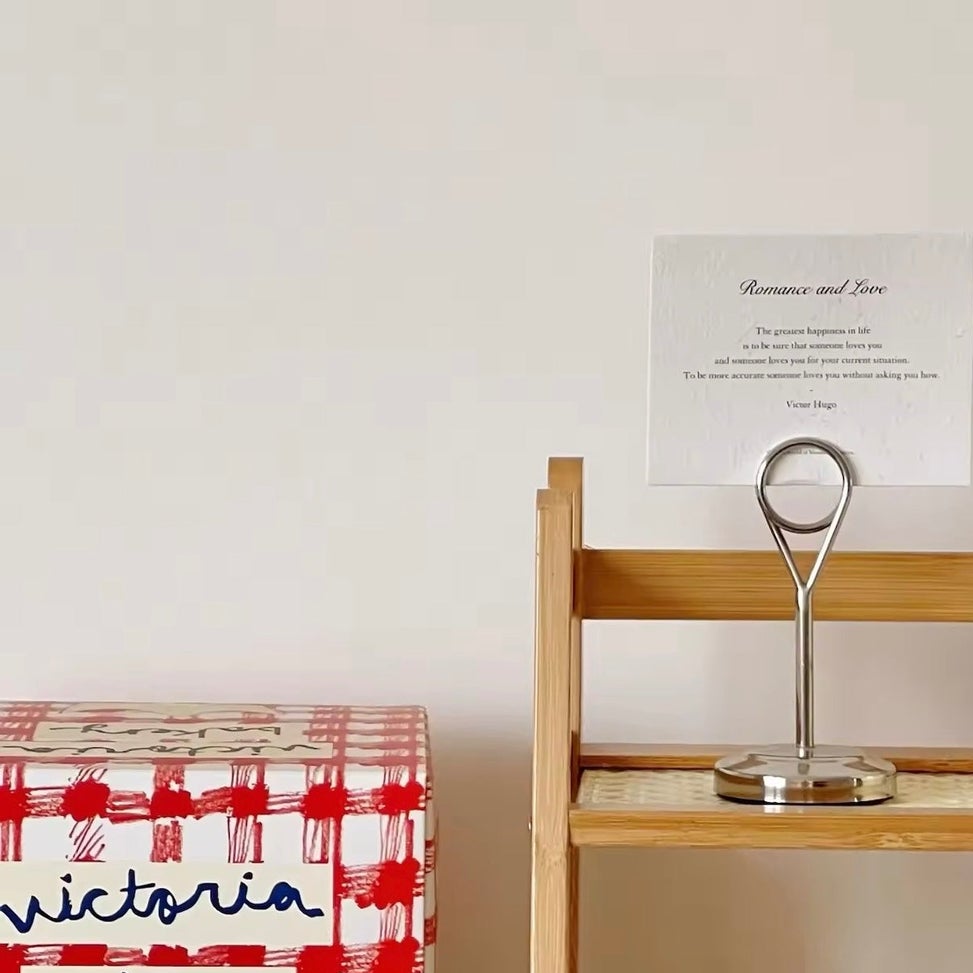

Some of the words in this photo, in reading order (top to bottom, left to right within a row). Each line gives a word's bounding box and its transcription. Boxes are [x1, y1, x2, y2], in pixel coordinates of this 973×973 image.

[739, 278, 812, 296] Romance
[816, 279, 850, 296] and
[848, 278, 888, 297] Love
[756, 326, 772, 335] The
[774, 328, 805, 337] greatest
[807, 326, 846, 337] happiness
[848, 327, 856, 335] in
[858, 326, 871, 335] life
[761, 341, 771, 350] be
[791, 342, 807, 350] that
[846, 341, 866, 349] loves
[868, 343, 882, 351] you
[714, 356, 730, 365] and
[768, 356, 789, 365] loves
[790, 359, 806, 367] you
[807, 355, 819, 365] for
[821, 358, 840, 367] your
[841, 357, 871, 365] current
[683, 371, 696, 379] To
[697, 371, 707, 379] be
[803, 370, 823, 379] loves
[825, 373, 840, 381] you
[842, 370, 873, 379] without
[875, 370, 902, 381] asking
[903, 373, 919, 381] you
[786, 400, 811, 409] Victor
[813, 400, 837, 410] Hugo
[0, 868, 325, 934] victoria
